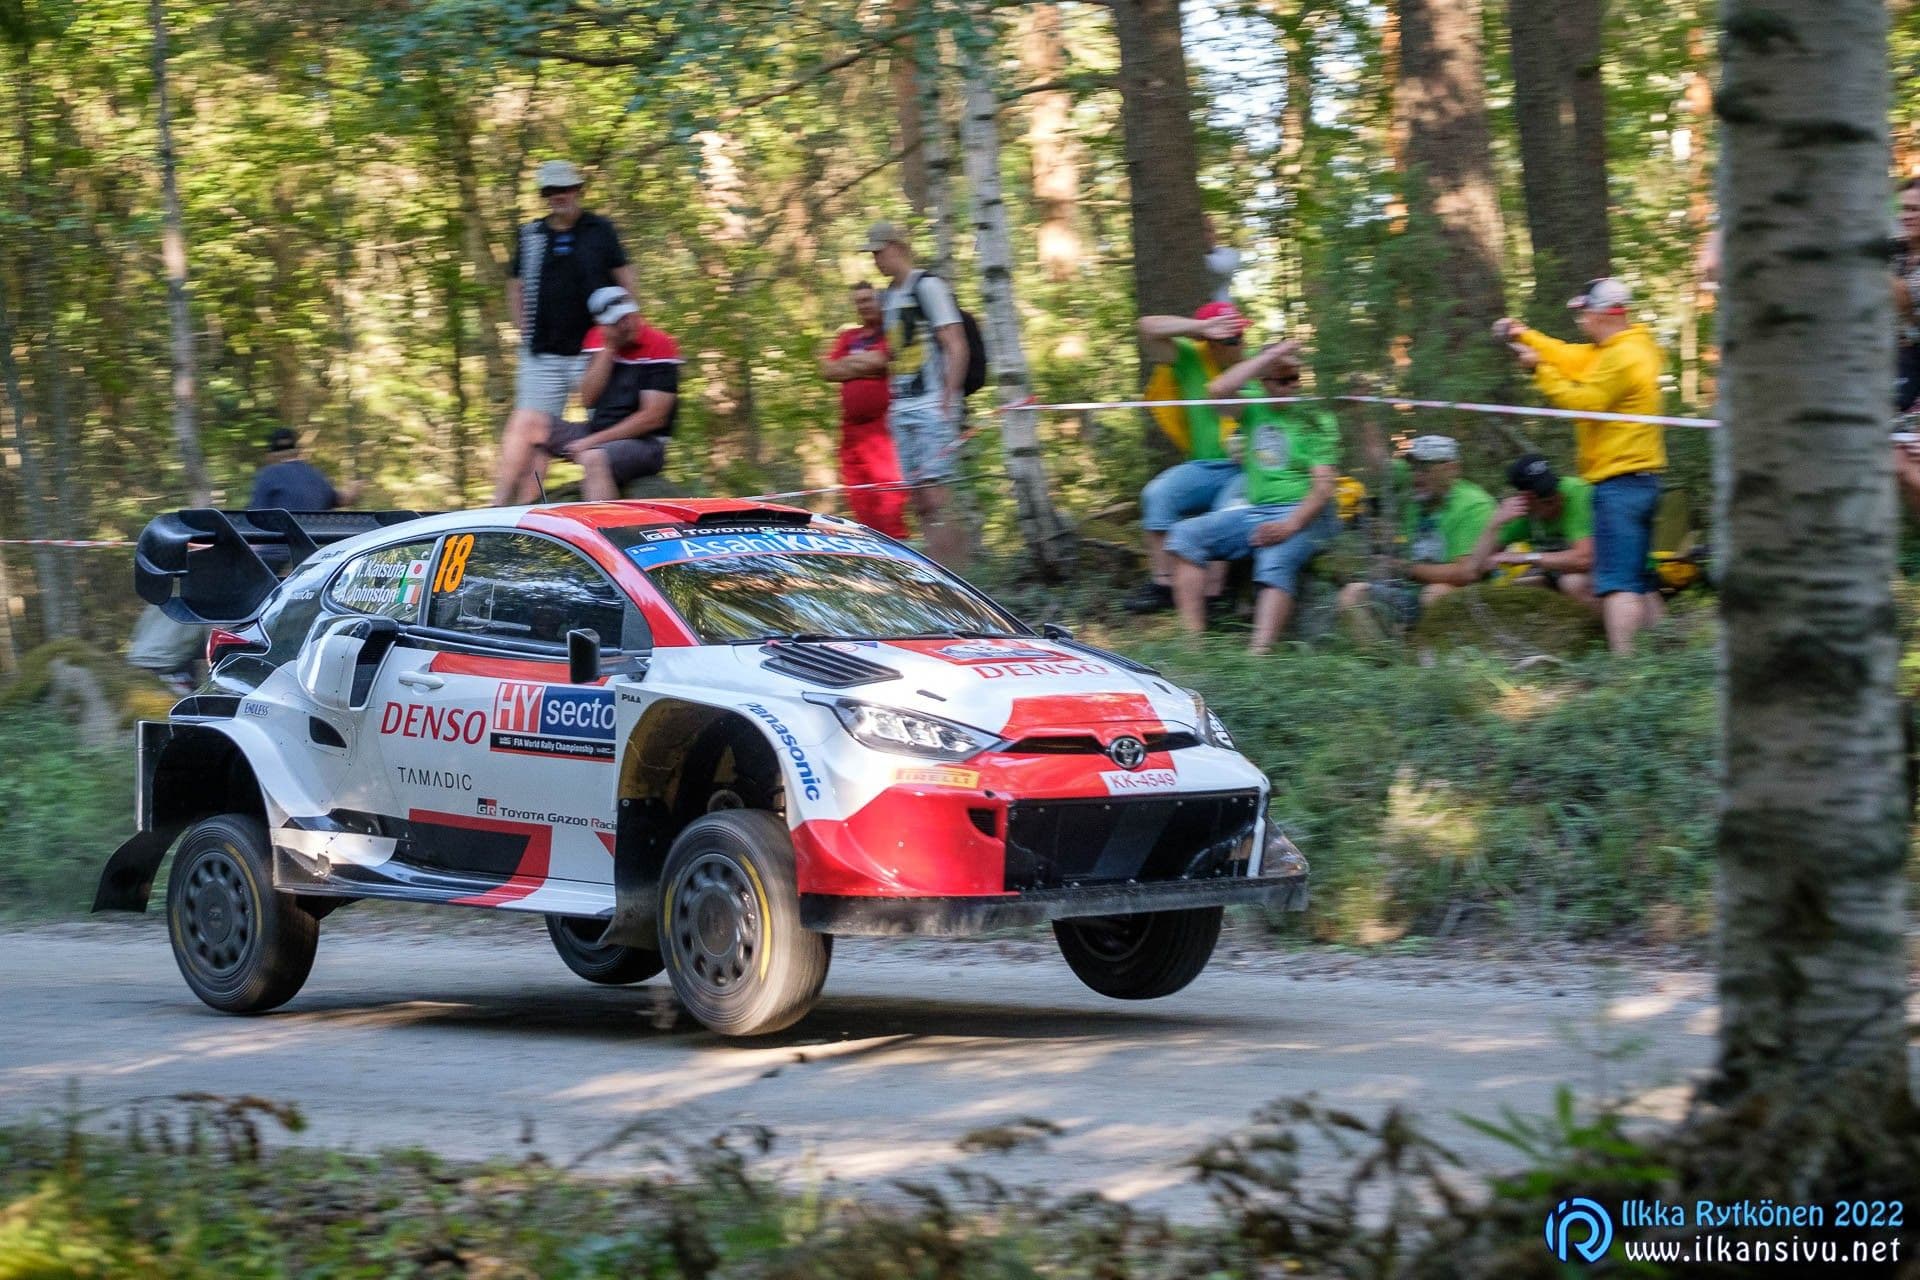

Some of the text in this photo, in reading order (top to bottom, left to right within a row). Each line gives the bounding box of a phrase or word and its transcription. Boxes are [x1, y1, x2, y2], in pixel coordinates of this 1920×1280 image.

[683, 527, 757, 535] TOYOTA
[433, 534, 475, 592] 18
[972, 663, 1109, 679] DENSO
[494, 683, 543, 732] HY
[622, 693, 641, 704] PIAA
[380, 702, 487, 744] DENSO
[546, 698, 616, 729] secto
[513, 738, 523, 747] FIA
[524, 739, 540, 748] World
[541, 741, 554, 751] Rally
[555, 742, 594, 754] Championship
[738, 702, 822, 801] Panasonic
[397, 767, 472, 791] TAMADIC
[1110, 773, 1176, 789] KK-4549
[477, 801, 497, 816] GR
[500, 807, 545, 822] TOYOTA
[547, 813, 588, 827] GAZOO
